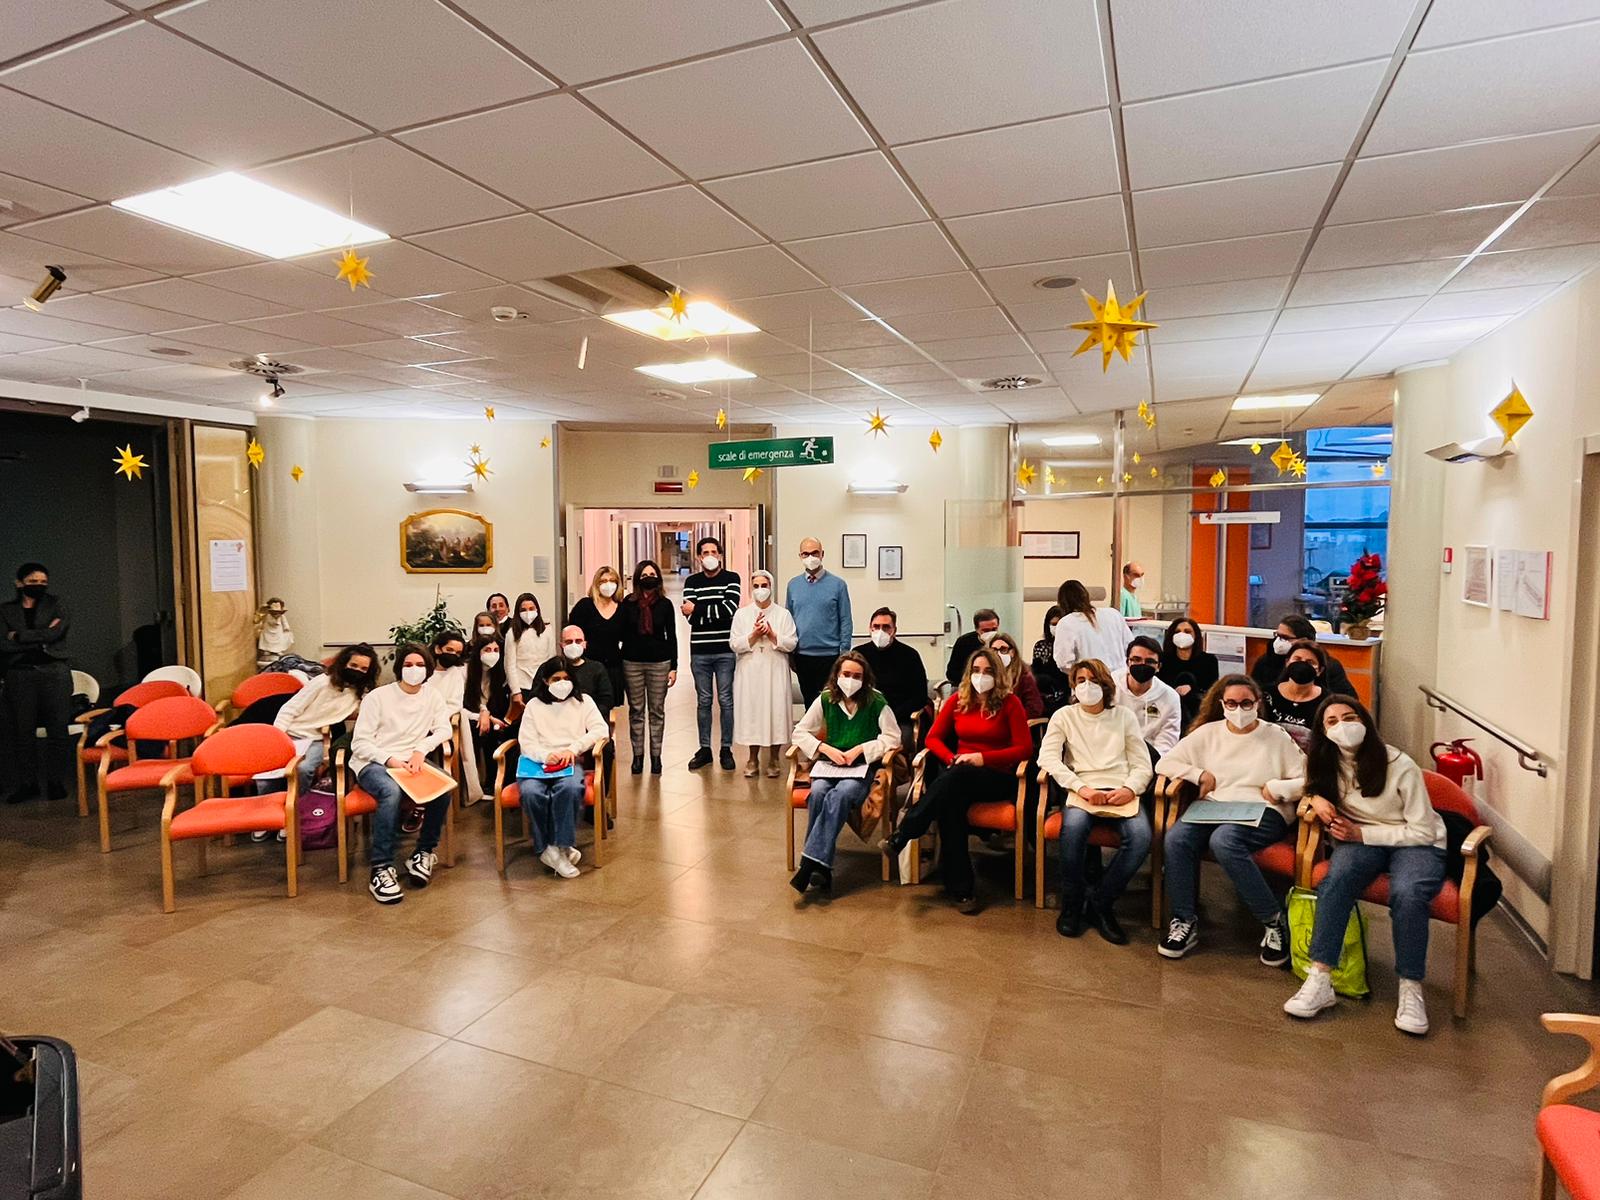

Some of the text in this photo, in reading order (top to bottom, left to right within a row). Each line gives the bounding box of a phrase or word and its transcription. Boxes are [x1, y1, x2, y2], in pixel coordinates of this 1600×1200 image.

[718, 450, 794, 462] scale di emergenza
